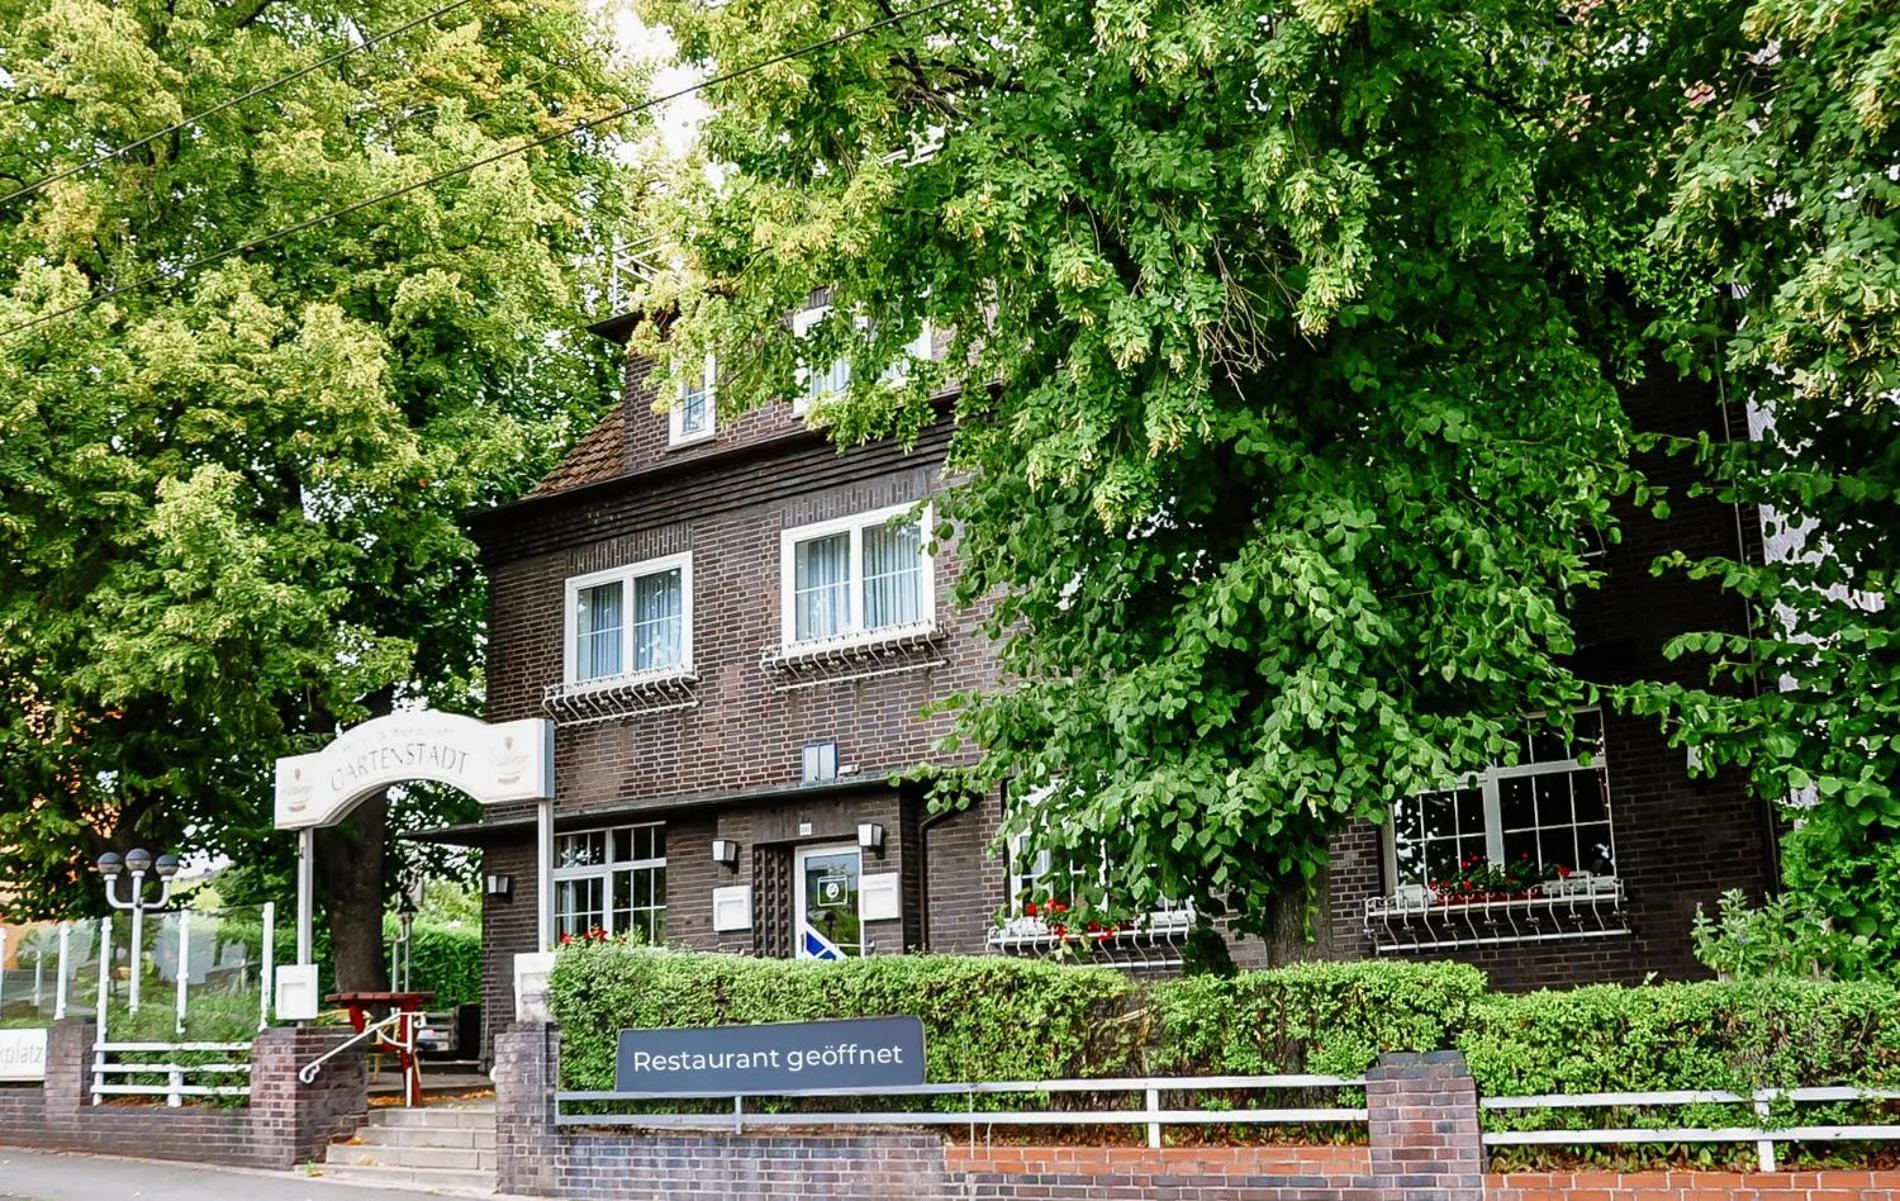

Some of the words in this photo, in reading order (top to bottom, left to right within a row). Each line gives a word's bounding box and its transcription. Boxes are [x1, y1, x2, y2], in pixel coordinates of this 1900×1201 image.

[331, 742, 471, 791] GARTENSTADT
[634, 1049, 780, 1072] Restaurant
[787, 1044, 903, 1072] geöffnet
